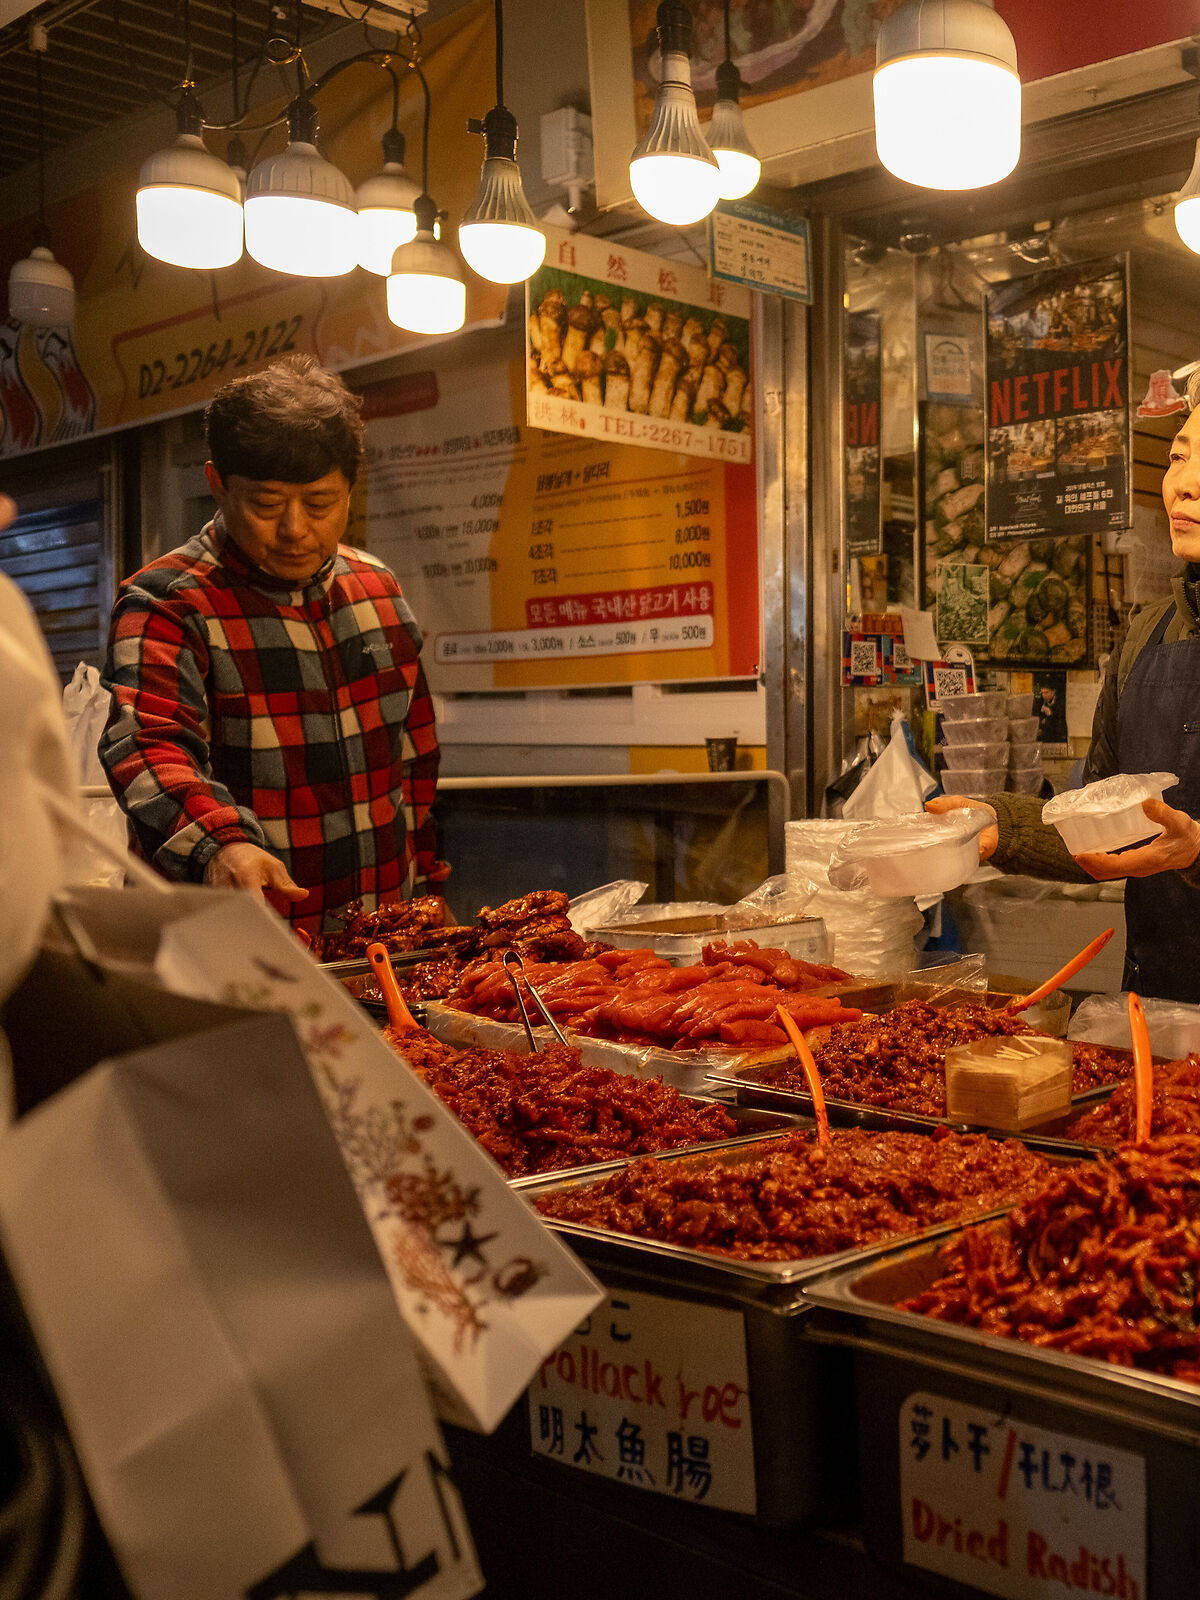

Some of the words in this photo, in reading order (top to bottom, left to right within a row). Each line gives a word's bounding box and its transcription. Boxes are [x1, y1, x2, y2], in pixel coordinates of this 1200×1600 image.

[137, 314, 304, 400] 02-2264-2122
[991, 358, 1124, 427] NETFLIX
[600, 414, 748, 458] TEL:2267-1751
[675, 499, 710, 518] 1,500원
[1064, 502, 1091, 515] 대한민국
[668, 551, 711, 571] 10,000원
[530, 602, 557, 624] 모든
[559, 599, 589, 622] 메뉴
[591, 594, 636, 619] 국내산
[639, 589, 679, 616] 닭고기
[682, 586, 711, 611] 사용
[681, 625, 707, 641] 500원
[676, 1378, 742, 1430] roe
[912, 1497, 1009, 1569] Dried
[1026, 1529, 1140, 1600] Radish
